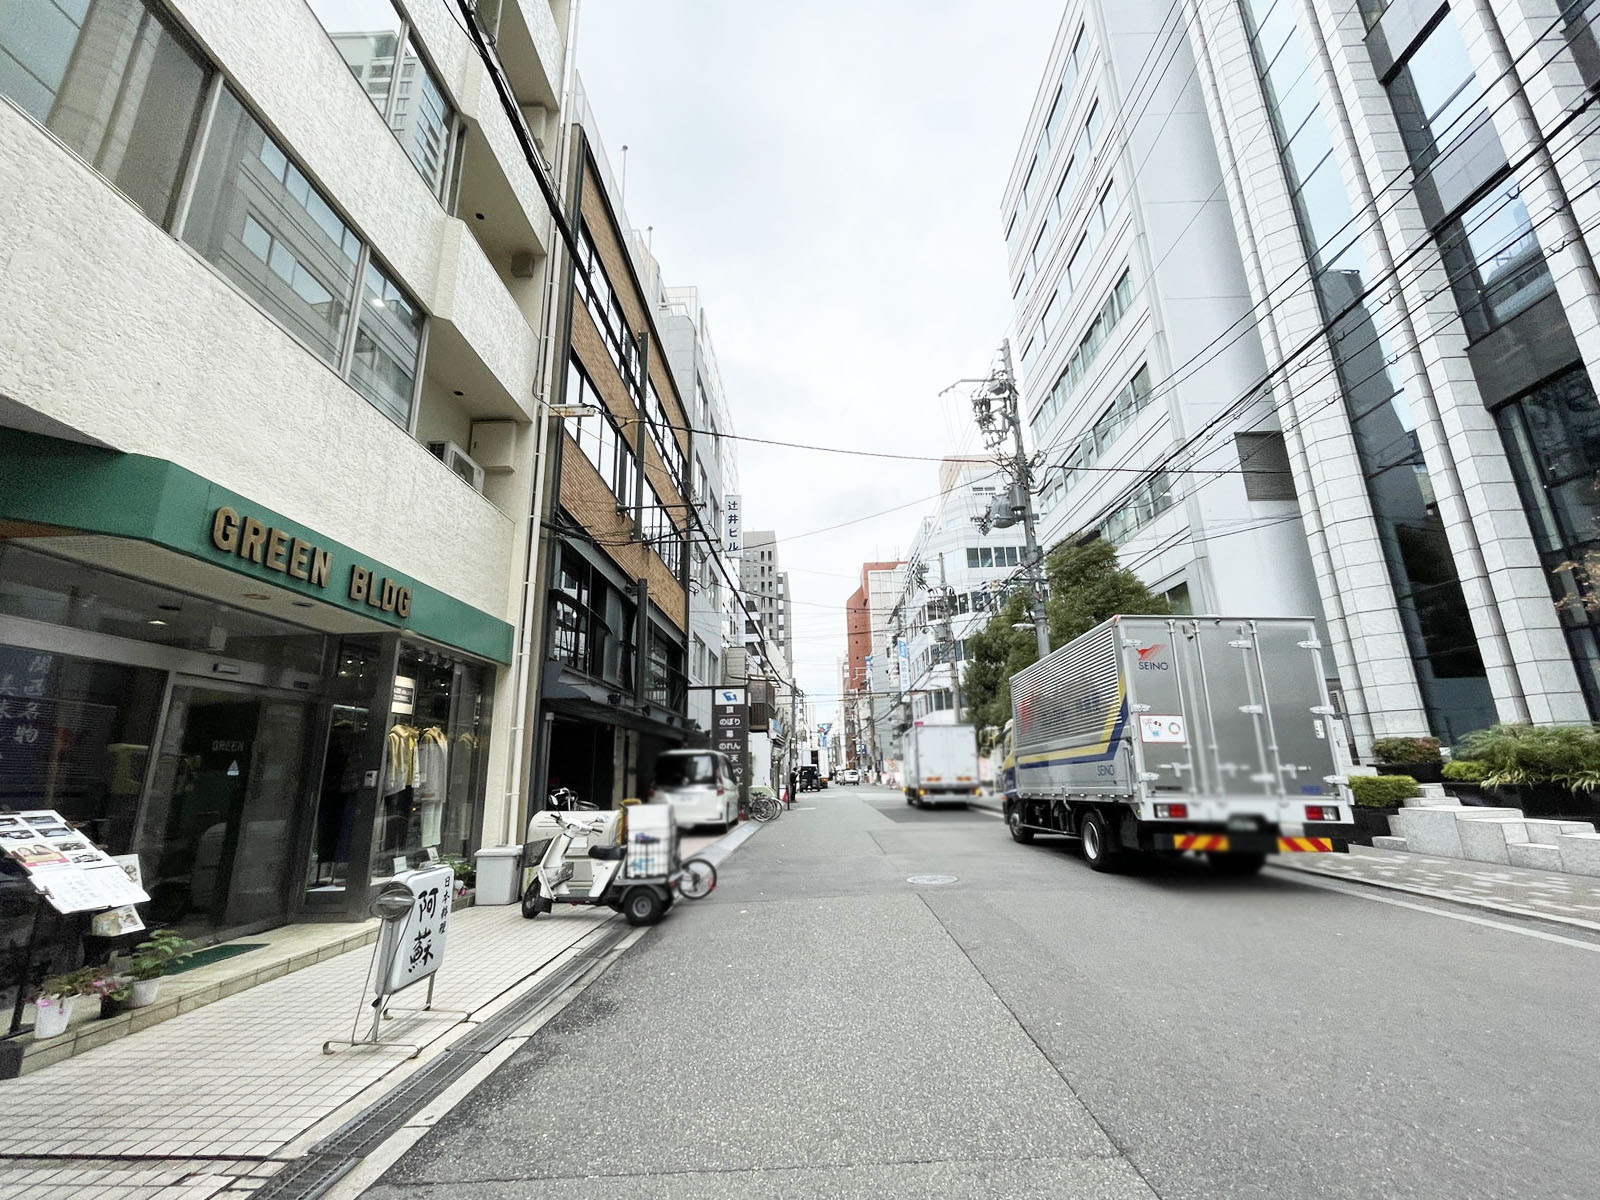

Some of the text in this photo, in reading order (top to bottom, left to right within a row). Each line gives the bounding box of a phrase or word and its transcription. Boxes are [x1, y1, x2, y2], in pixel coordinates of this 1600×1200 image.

[728, 501, 739, 551] 辻井ビル
[212, 506, 412, 618] GREEN BLDG
[1138, 661, 1169, 671] SEINO
[719, 718, 741, 726] のぼり
[719, 742, 741, 751] のれん
[1096, 763, 1115, 777] SEINO
[439, 876, 451, 935] 日本料理
[408, 887, 439, 973] 阿蘇
